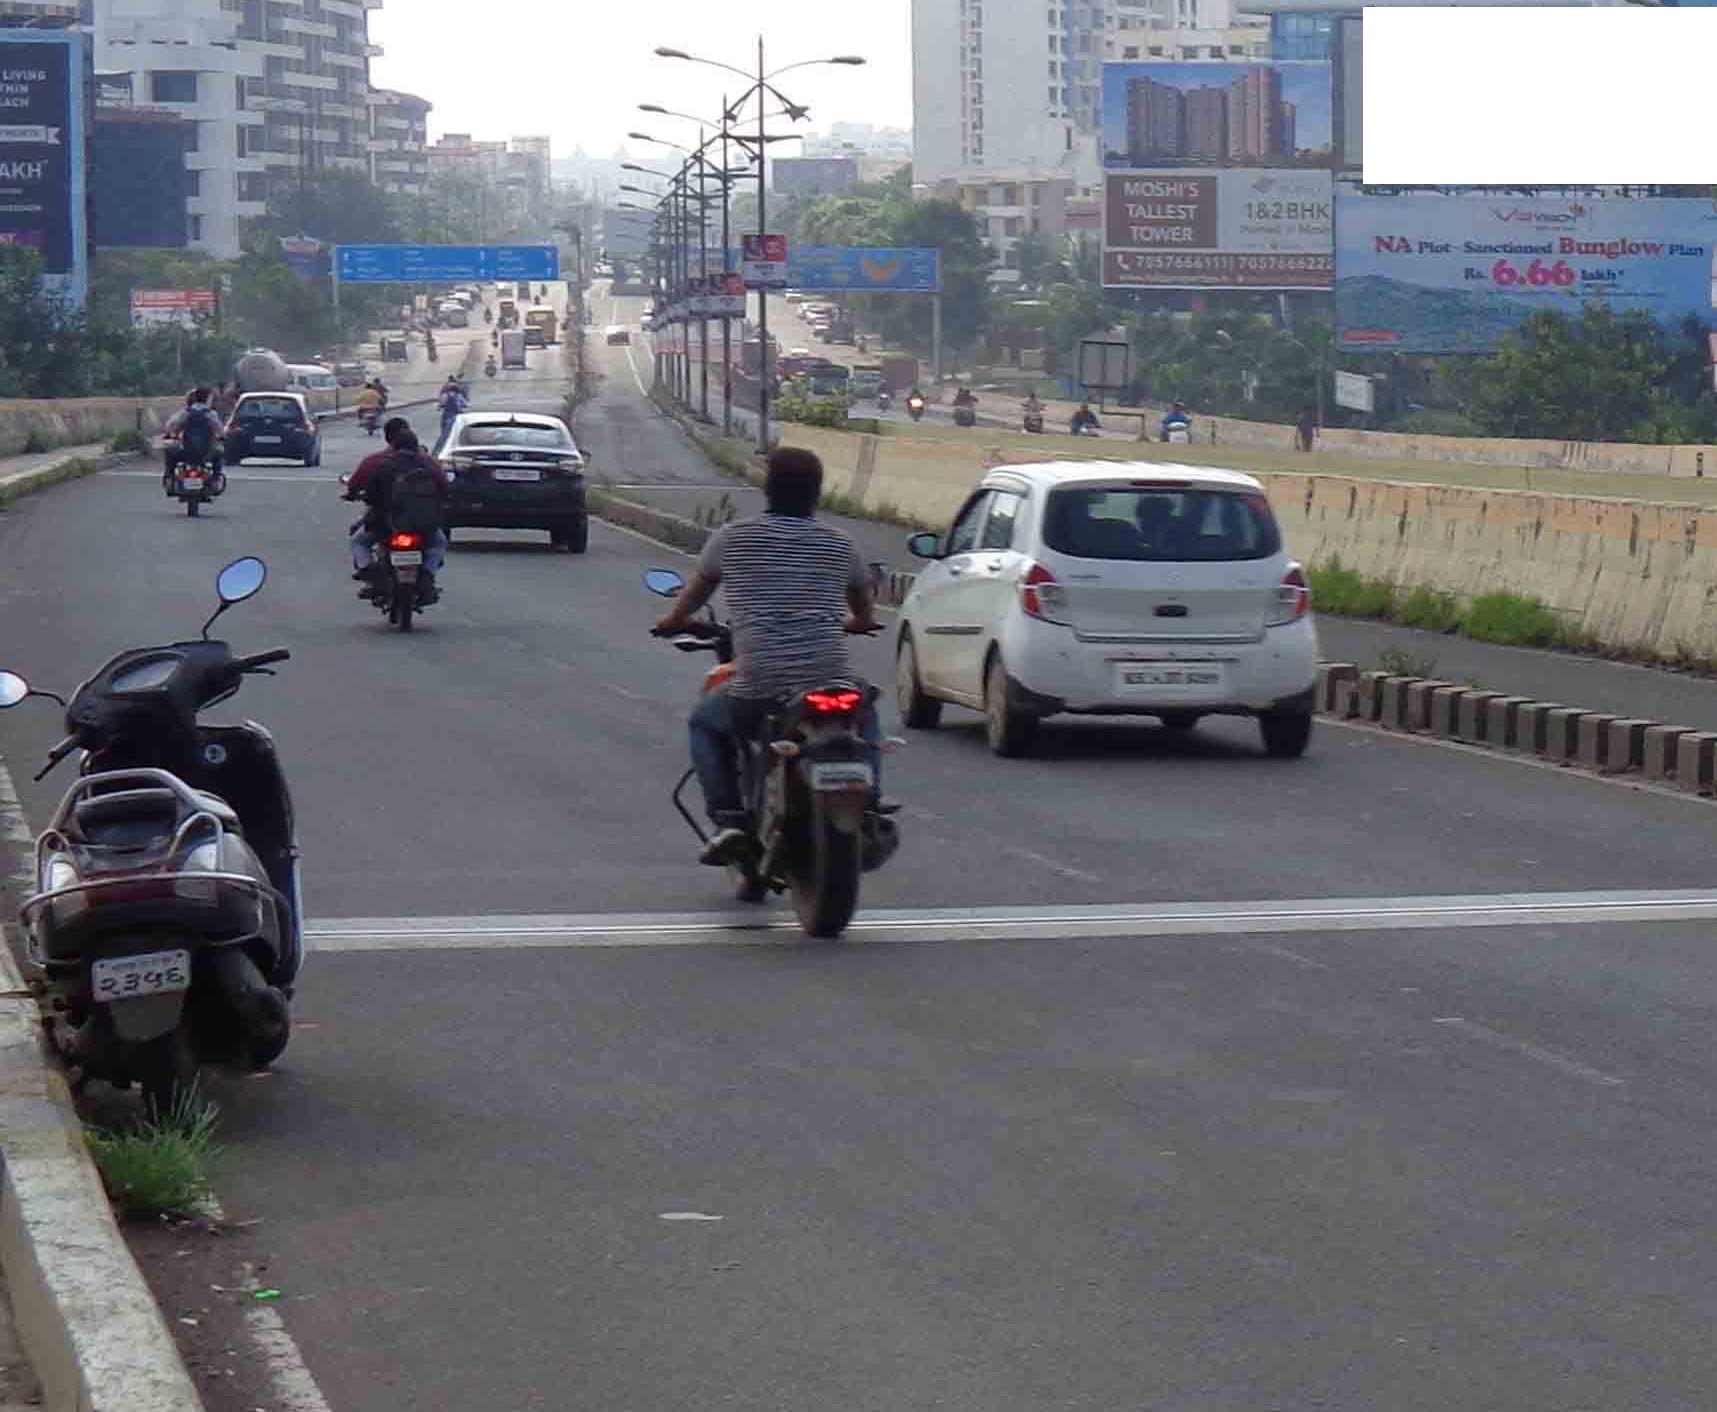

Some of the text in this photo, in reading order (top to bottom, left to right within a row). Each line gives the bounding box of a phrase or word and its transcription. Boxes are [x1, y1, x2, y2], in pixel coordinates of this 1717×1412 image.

[1123, 181, 1200, 197] MOSHI'S
[1125, 203, 1198, 220] TALLEST
[1129, 226, 1193, 242] TOWER
[1372, 235, 1705, 260] NA Plot Sanctioned Bunglow Plan
[1491, 259, 1576, 286] 6.66
